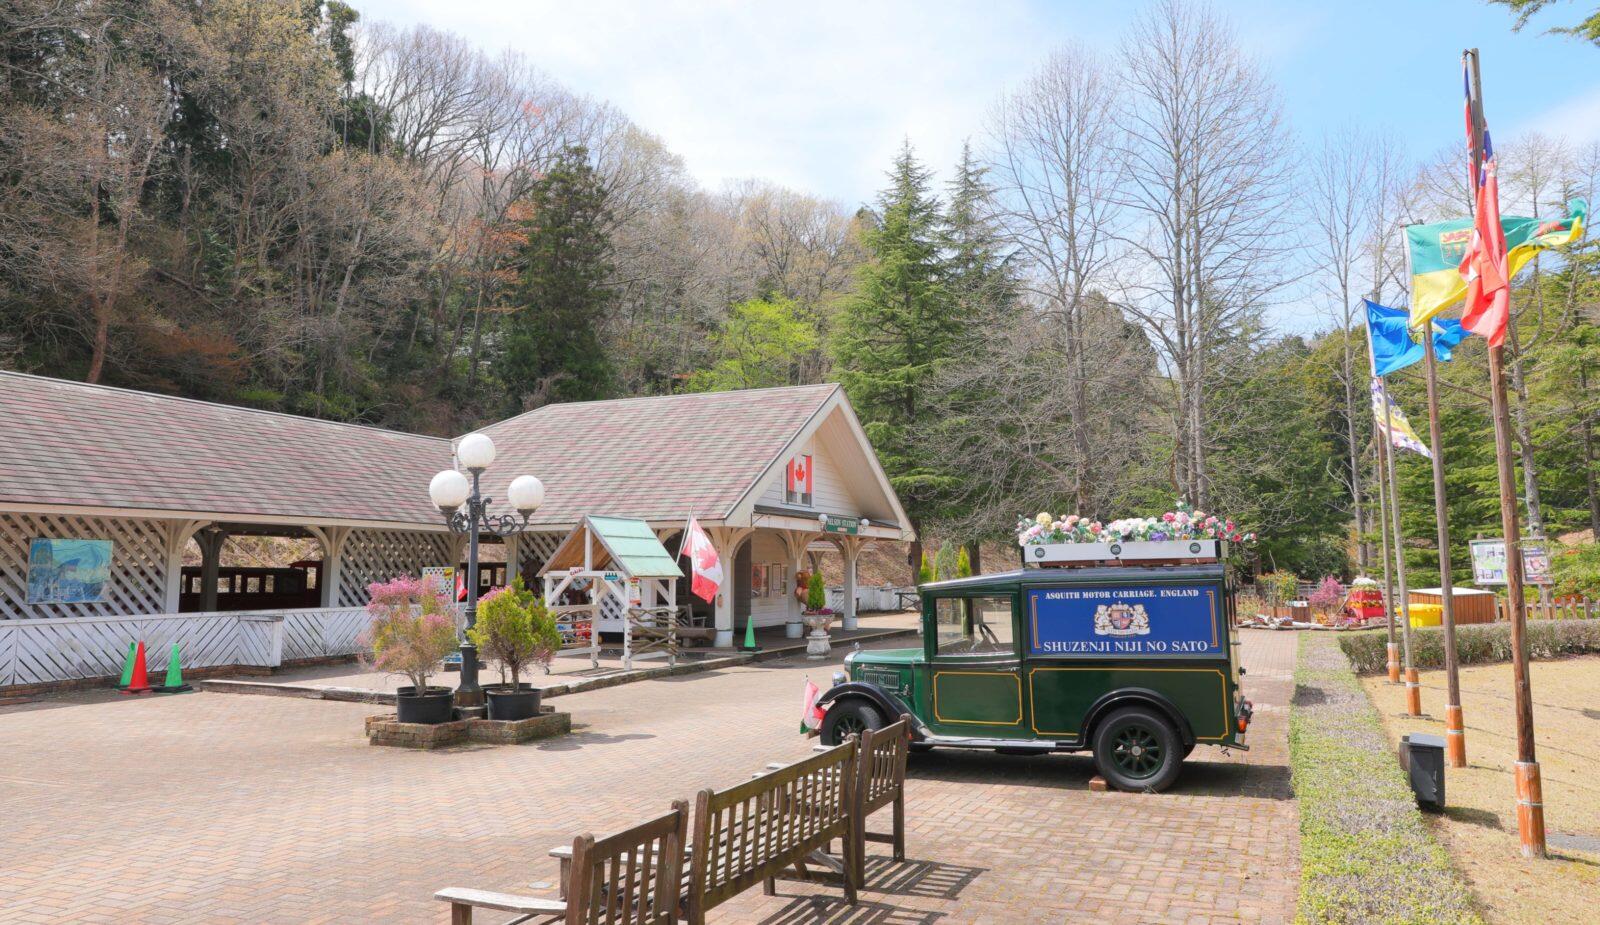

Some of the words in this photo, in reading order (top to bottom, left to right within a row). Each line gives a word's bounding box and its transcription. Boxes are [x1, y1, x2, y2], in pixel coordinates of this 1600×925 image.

[1045, 591, 1080, 600] ASQUITH
[1082, 590, 1111, 599] MOTOR
[1112, 590, 1157, 599] CARRIAGE.
[1160, 589, 1199, 597] ENGLAND
[1043, 641, 1110, 652] SHUZENJI
[1115, 641, 1142, 652] NIJI
[1146, 640, 1167, 652] NO
[1171, 640, 1208, 652] SATO
